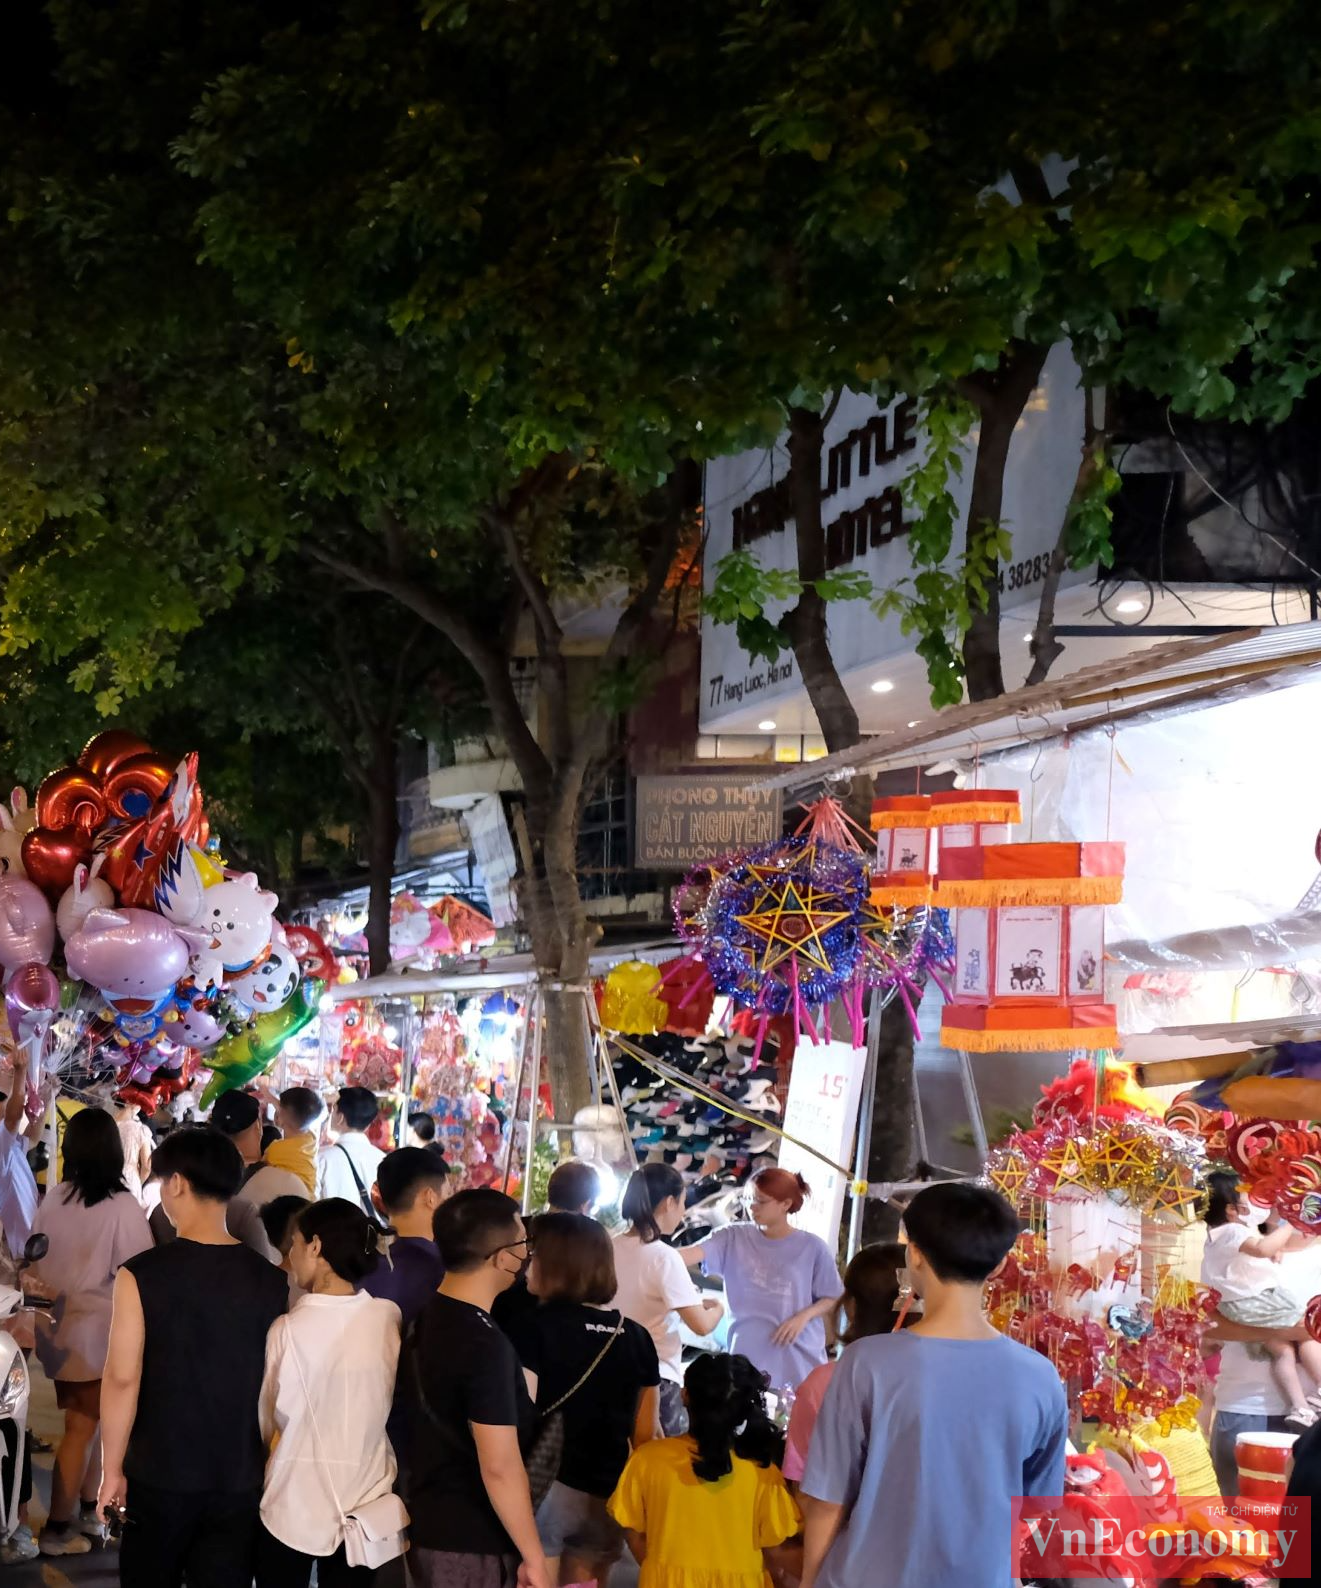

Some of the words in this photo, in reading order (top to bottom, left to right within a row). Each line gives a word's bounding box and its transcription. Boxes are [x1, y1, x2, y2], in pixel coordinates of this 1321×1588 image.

[821, 394, 918, 497] ITTLE
[710, 674, 724, 707] 77
[646, 787, 718, 805] PHONG
[645, 805, 685, 843] CÁT
[689, 805, 773, 843] NGUYÊN
[646, 846, 674, 859] BÁN
[678, 845, 717, 860] BUÔN
